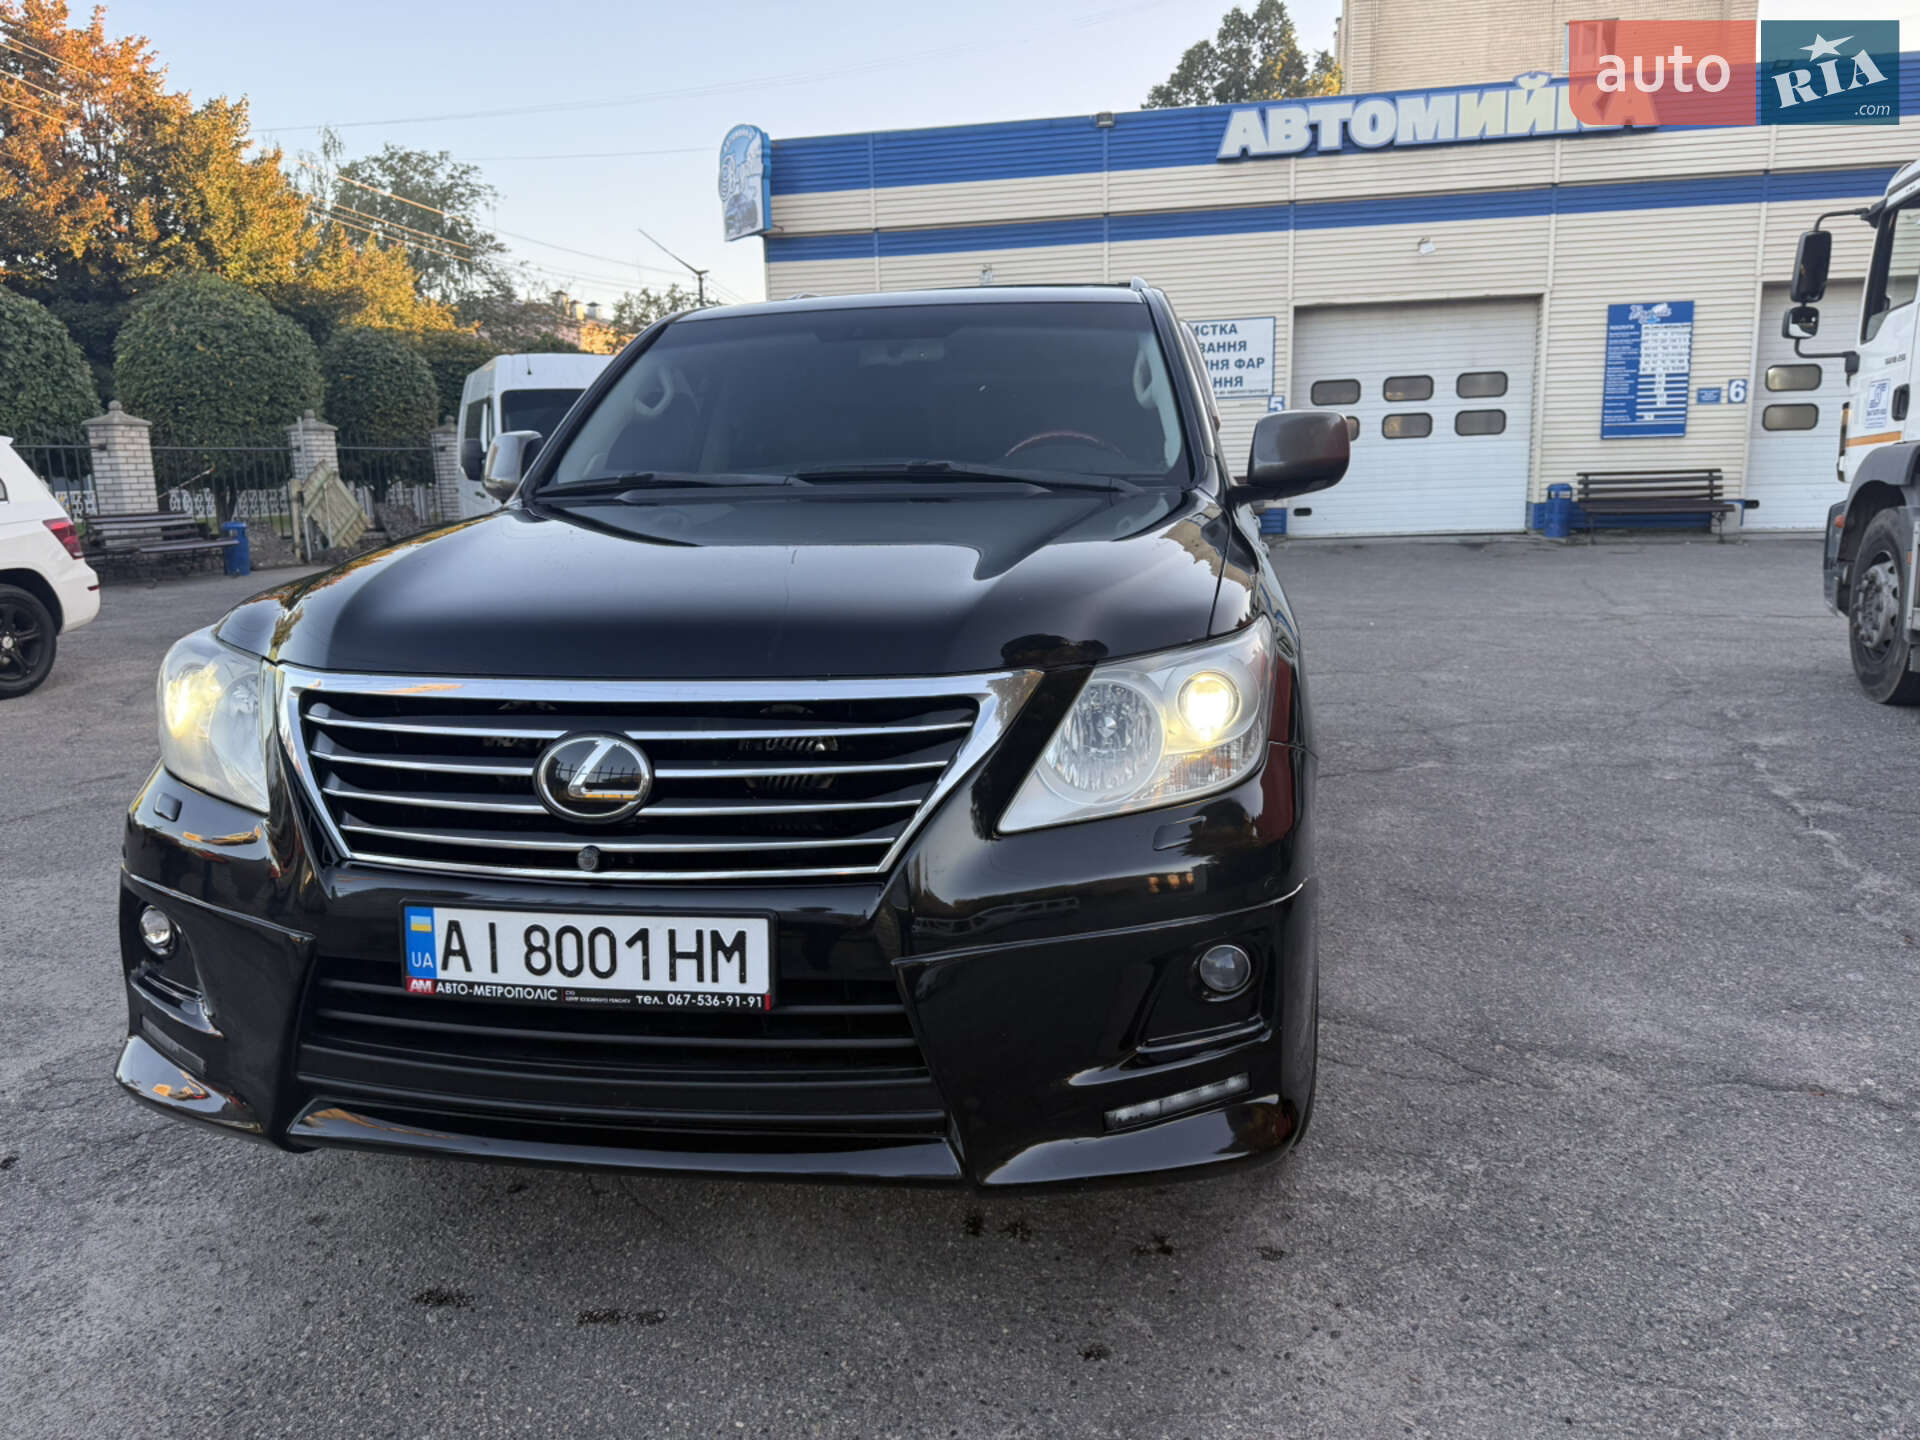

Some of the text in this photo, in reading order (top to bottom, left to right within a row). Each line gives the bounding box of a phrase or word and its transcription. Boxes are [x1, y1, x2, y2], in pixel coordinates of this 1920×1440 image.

[1217, 72, 1661, 159] АВТОМИЙКА
[1234, 357, 1265, 369] ФАР
[1730, 380, 1745, 402] 6
[1269, 397, 1284, 411] 5
[441, 919, 498, 974] AI
[523, 923, 650, 980] 8001
[411, 952, 434, 969] UA
[635, 994, 664, 1005] тел.
[667, 993, 763, 1008] 067-536-91-91
